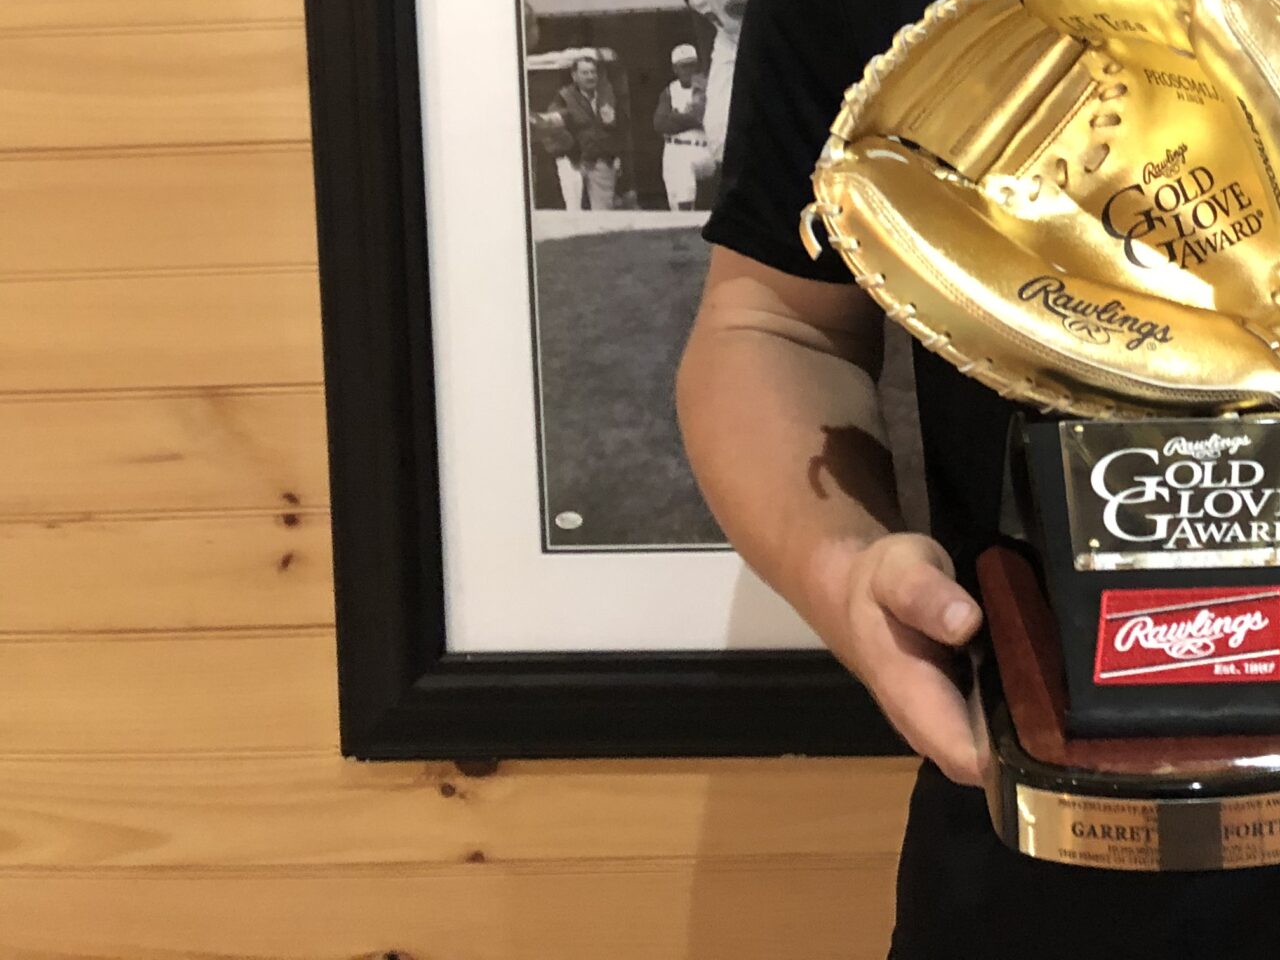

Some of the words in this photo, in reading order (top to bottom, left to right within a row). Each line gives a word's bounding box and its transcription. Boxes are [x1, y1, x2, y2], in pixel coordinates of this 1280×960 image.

[1143, 142, 1188, 185] Rawlings
[1102, 166, 1214, 240] GOLD
[1124, 181, 1253, 269] GLOVE
[1018, 275, 1173, 350] Rawlings
[1163, 433, 1252, 457] Rawlings
[1090, 448, 1265, 504] GOLD
[1114, 609, 1269, 654] Rawlings
